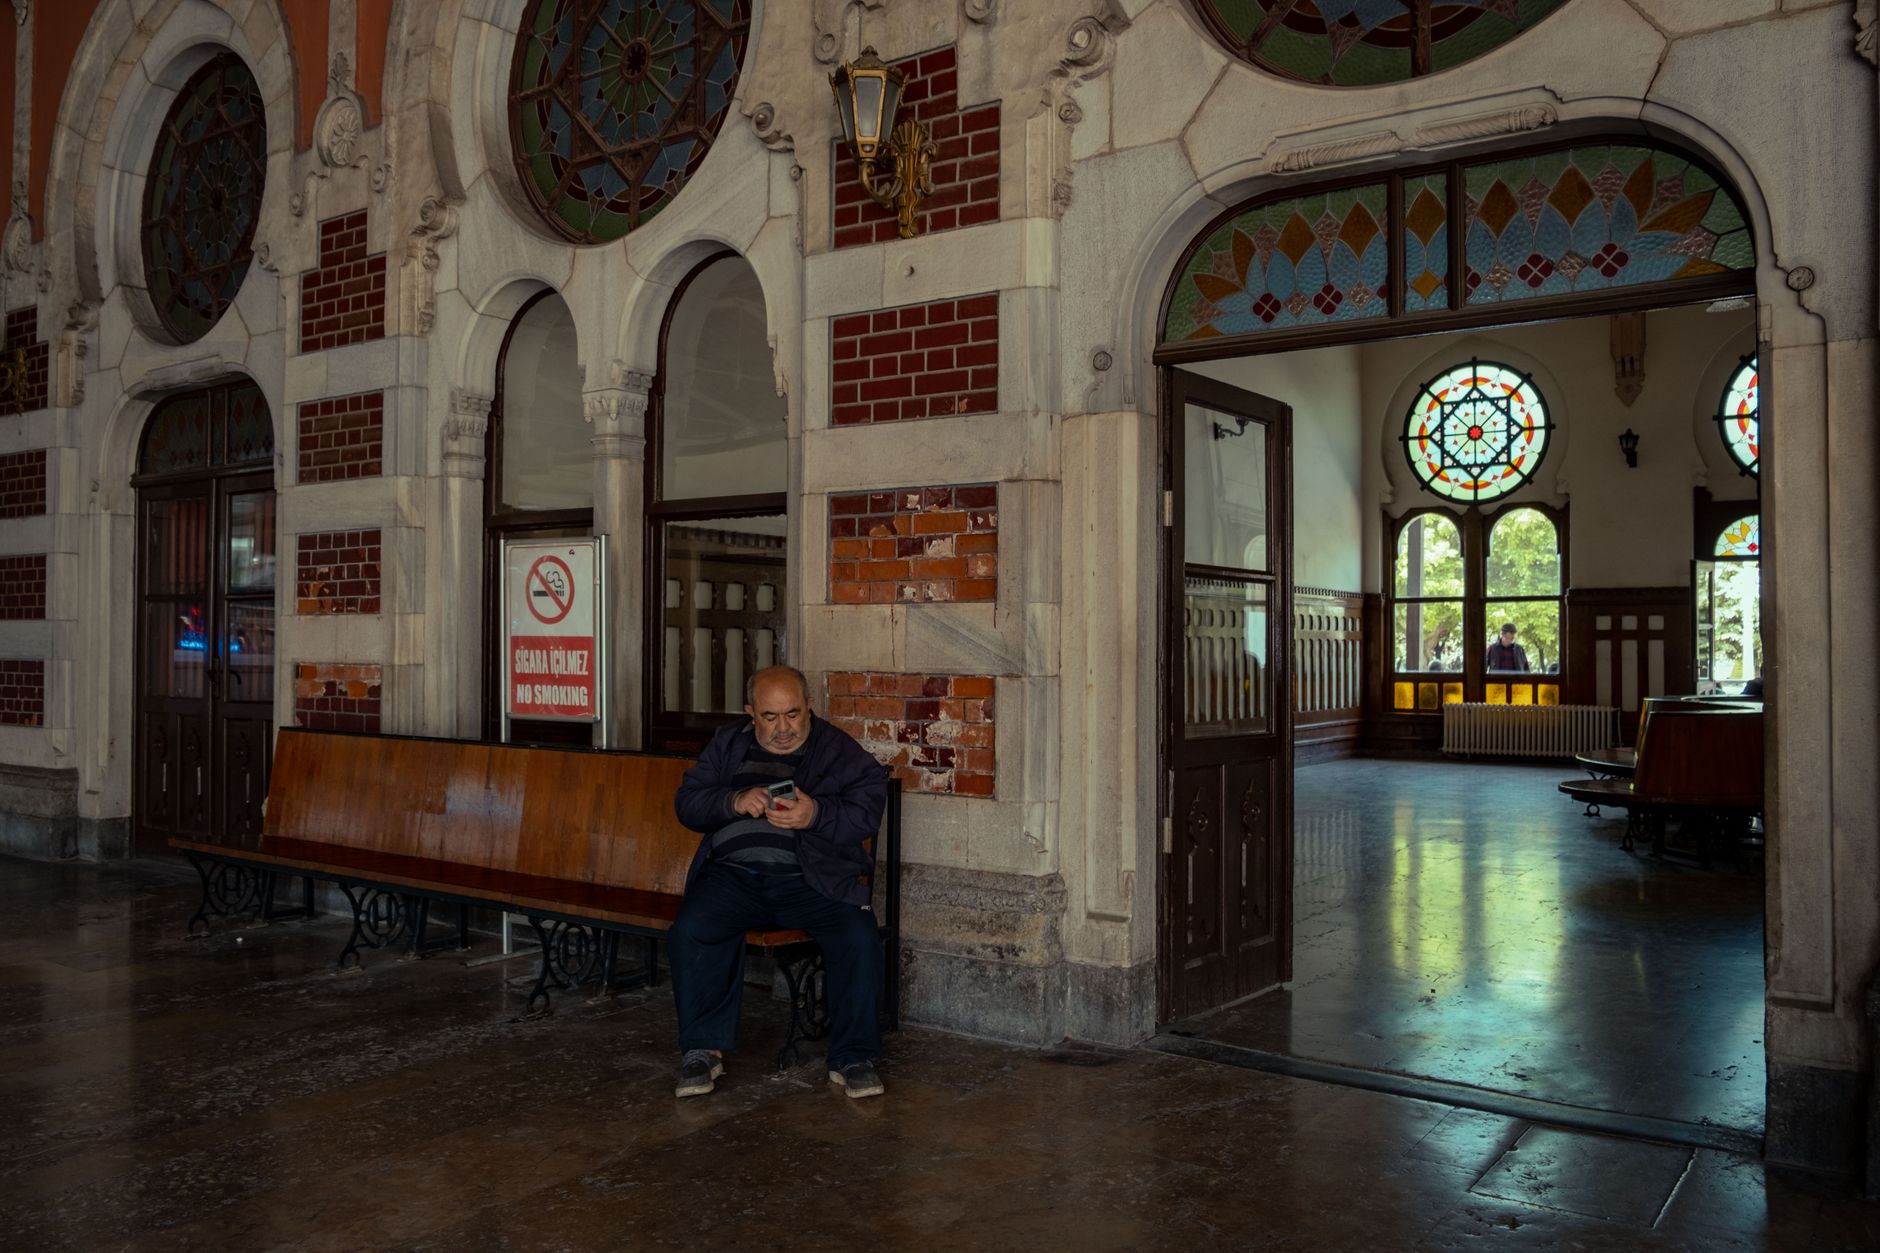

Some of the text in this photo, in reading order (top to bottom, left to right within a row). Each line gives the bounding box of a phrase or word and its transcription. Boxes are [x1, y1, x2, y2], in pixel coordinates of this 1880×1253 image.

[515, 646, 589, 678] SİGARA İÇİLMEZ
[516, 684, 588, 706] NO SMOKING
